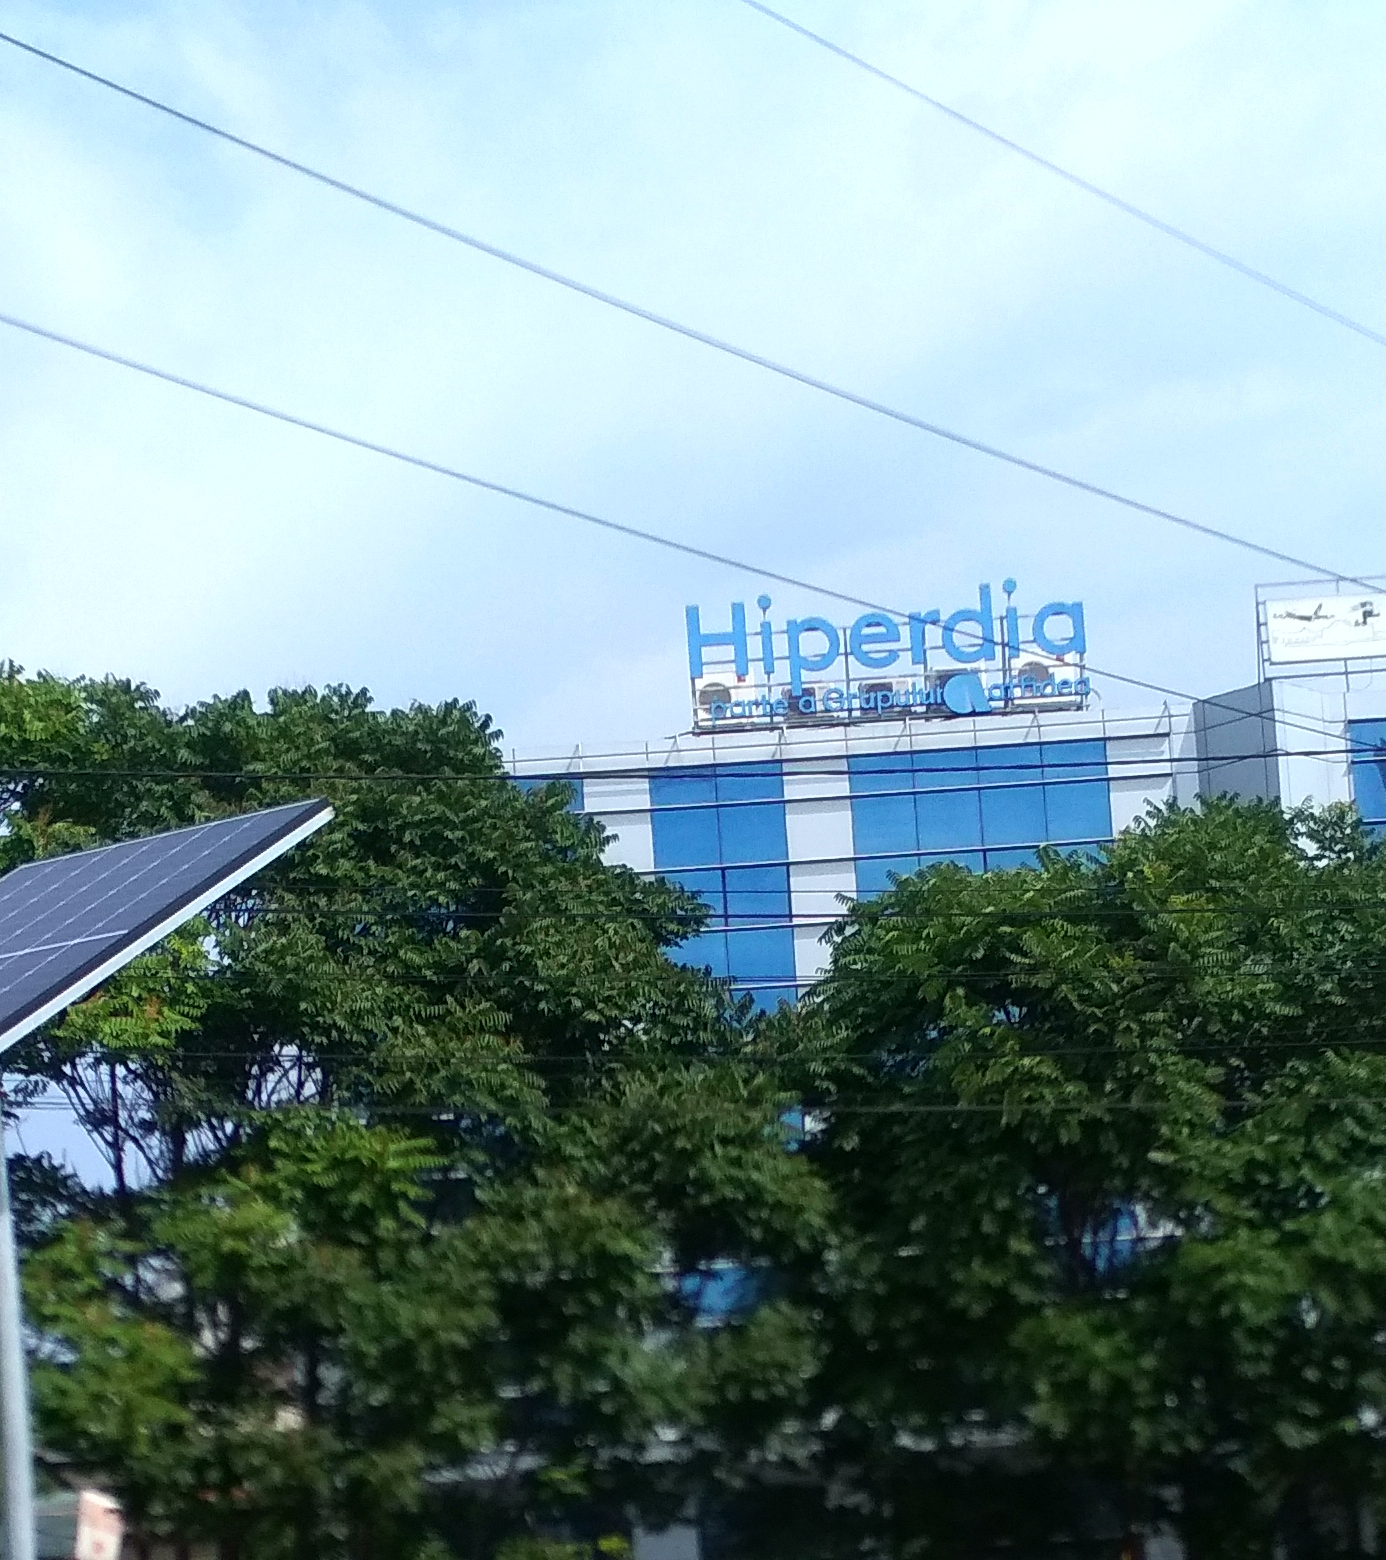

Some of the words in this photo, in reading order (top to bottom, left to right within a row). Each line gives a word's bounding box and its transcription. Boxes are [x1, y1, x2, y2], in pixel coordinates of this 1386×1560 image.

[685, 577, 1087, 696] Hiperdia
[710, 695, 789, 729] parte
[822, 681, 943, 716] Grupului
